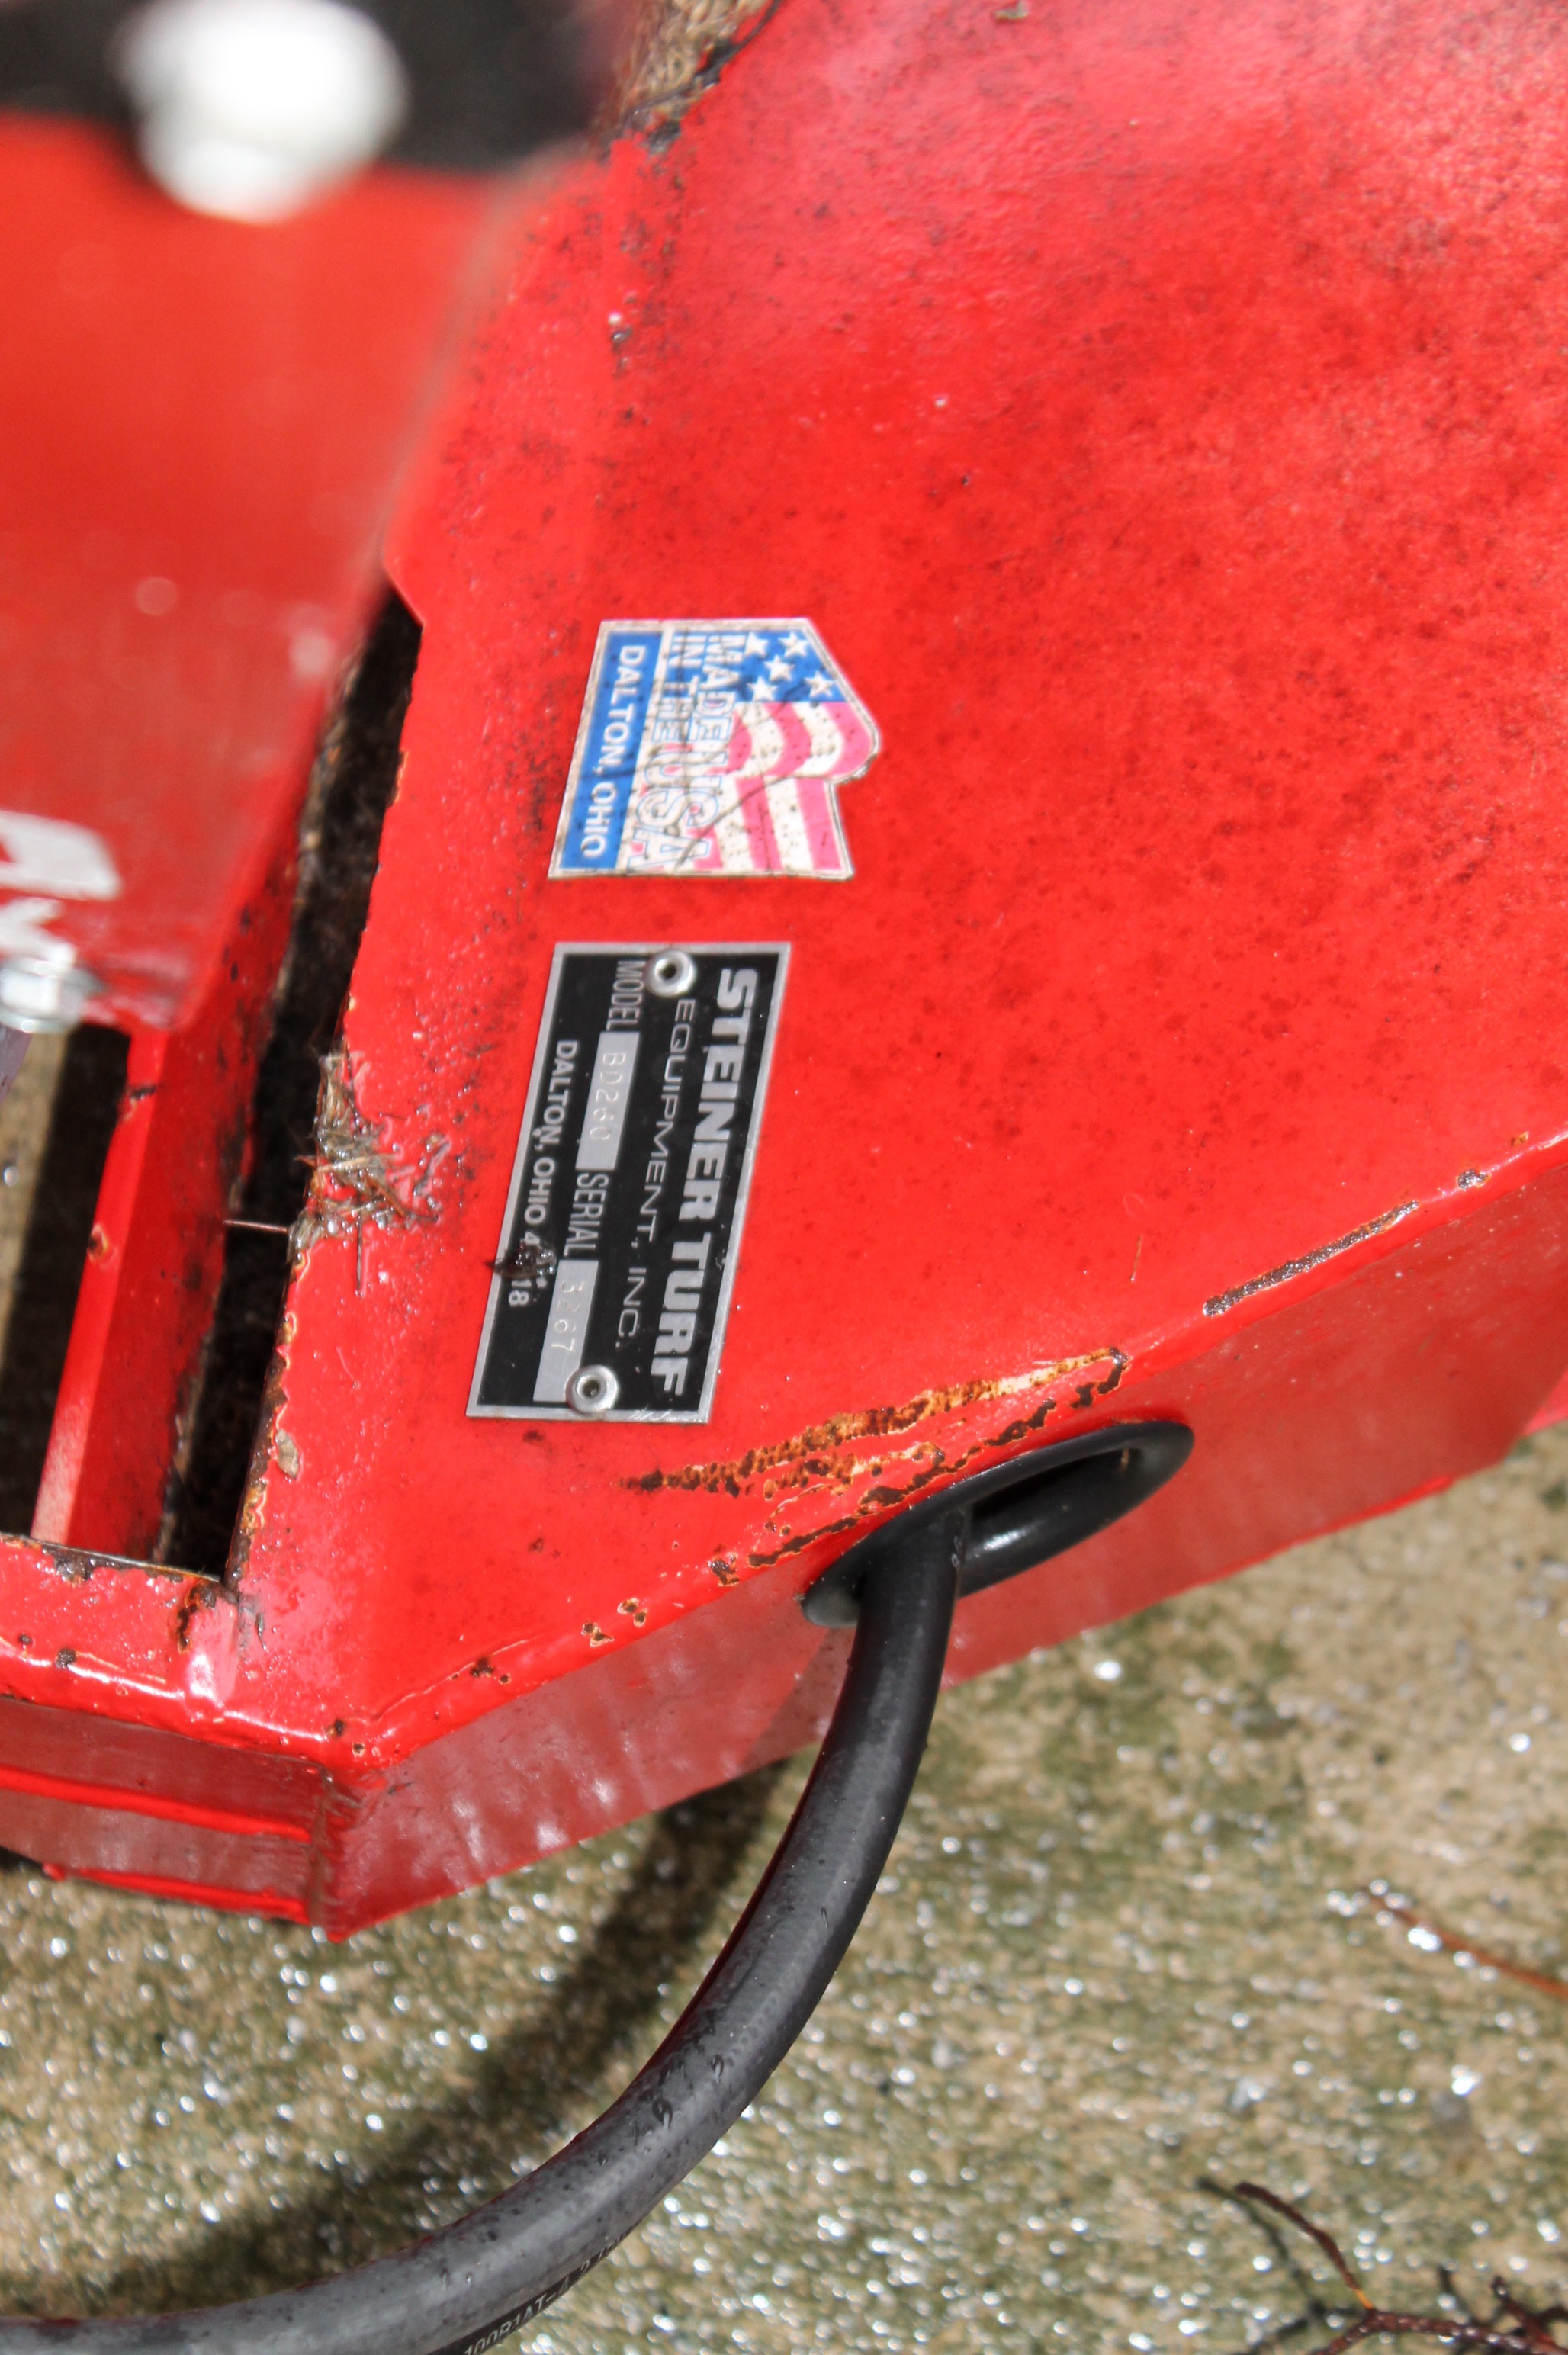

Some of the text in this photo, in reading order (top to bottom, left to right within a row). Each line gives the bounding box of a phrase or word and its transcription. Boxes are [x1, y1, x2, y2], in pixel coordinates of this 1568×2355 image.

[653, 634, 707, 743] IN THE
[688, 633, 747, 742] MADE
[580, 644, 646, 858] DALTON, OHIO
[627, 750, 730, 872] USA
[606, 960, 647, 1031] MODEL
[508, 1040, 580, 1307] DALTON, OHIO 418
[564, 1172, 609, 1257] SERIAL
[615, 998, 697, 1348] EQUIPMENT, INC.
[651, 968, 759, 1396] STEINER TURF
